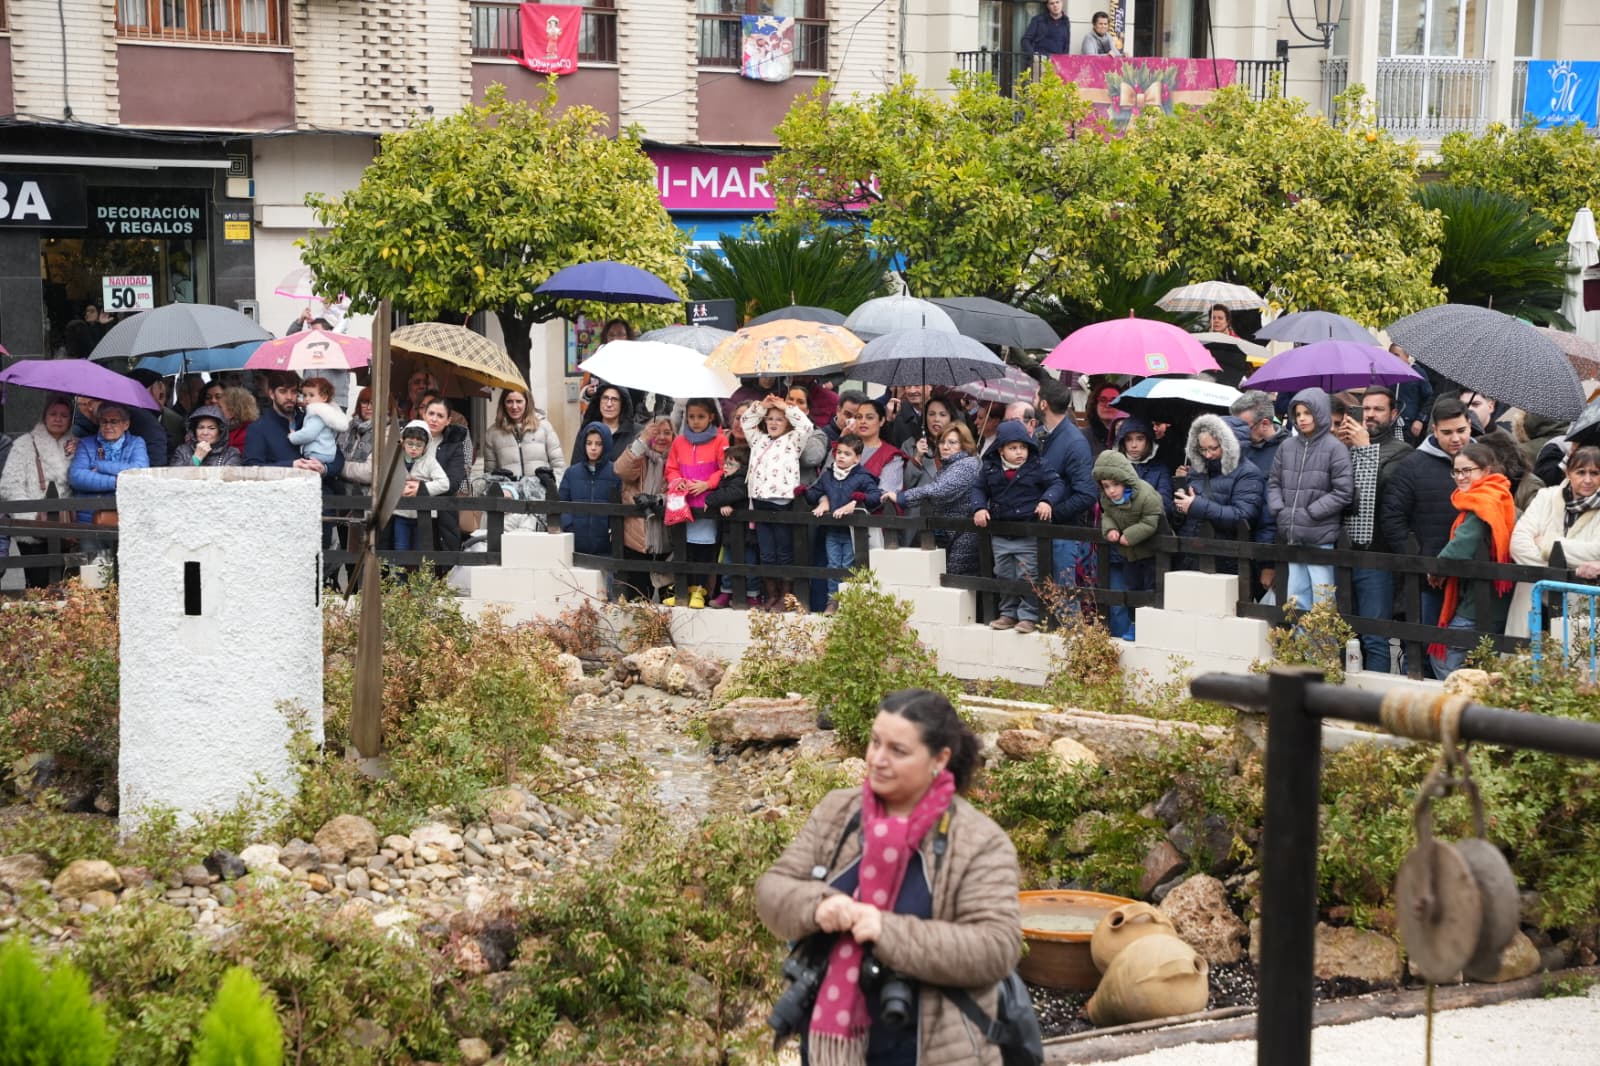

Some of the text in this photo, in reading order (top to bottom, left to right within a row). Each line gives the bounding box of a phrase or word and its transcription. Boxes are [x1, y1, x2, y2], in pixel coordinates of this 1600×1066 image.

[0, 180, 52, 221] A
[97, 204, 200, 219] DECORACIÓN
[105, 221, 193, 234] Y REGALOS
[108, 276, 148, 287] NAVIDAD
[111, 287, 136, 309] 50
